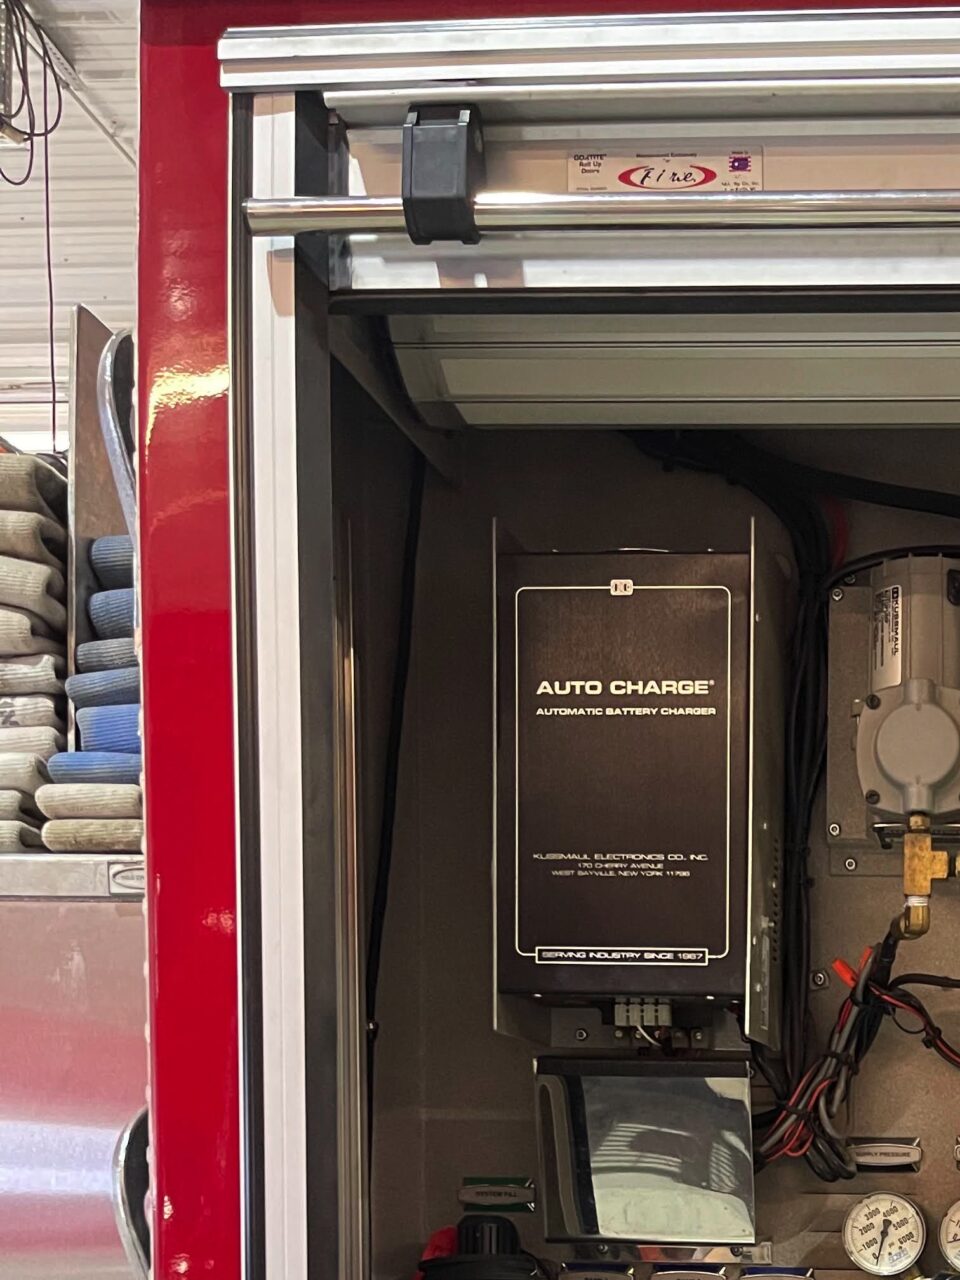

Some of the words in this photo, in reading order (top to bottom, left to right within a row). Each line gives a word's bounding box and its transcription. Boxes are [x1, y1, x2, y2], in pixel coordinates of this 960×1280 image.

[536, 680, 602, 695] AUTO
[536, 707, 603, 716] AUTOMATIC
[605, 707, 658, 716] BATTERY
[660, 707, 717, 716] CHARGER
[533, 853, 591, 861] KUSSMAUL
[594, 853, 665, 861] ELECTRONICS
[542, 951, 586, 959] SERVING
[589, 951, 641, 959] INDUSTRY
[643, 952, 675, 960] SINCE
[882, 1205, 899, 1218] 4000
[859, 1222, 875, 1236] 2000
[892, 1217, 909, 1231] 5000
[862, 1237, 878, 1250] 1000
[898, 1231, 915, 1245] 6000
